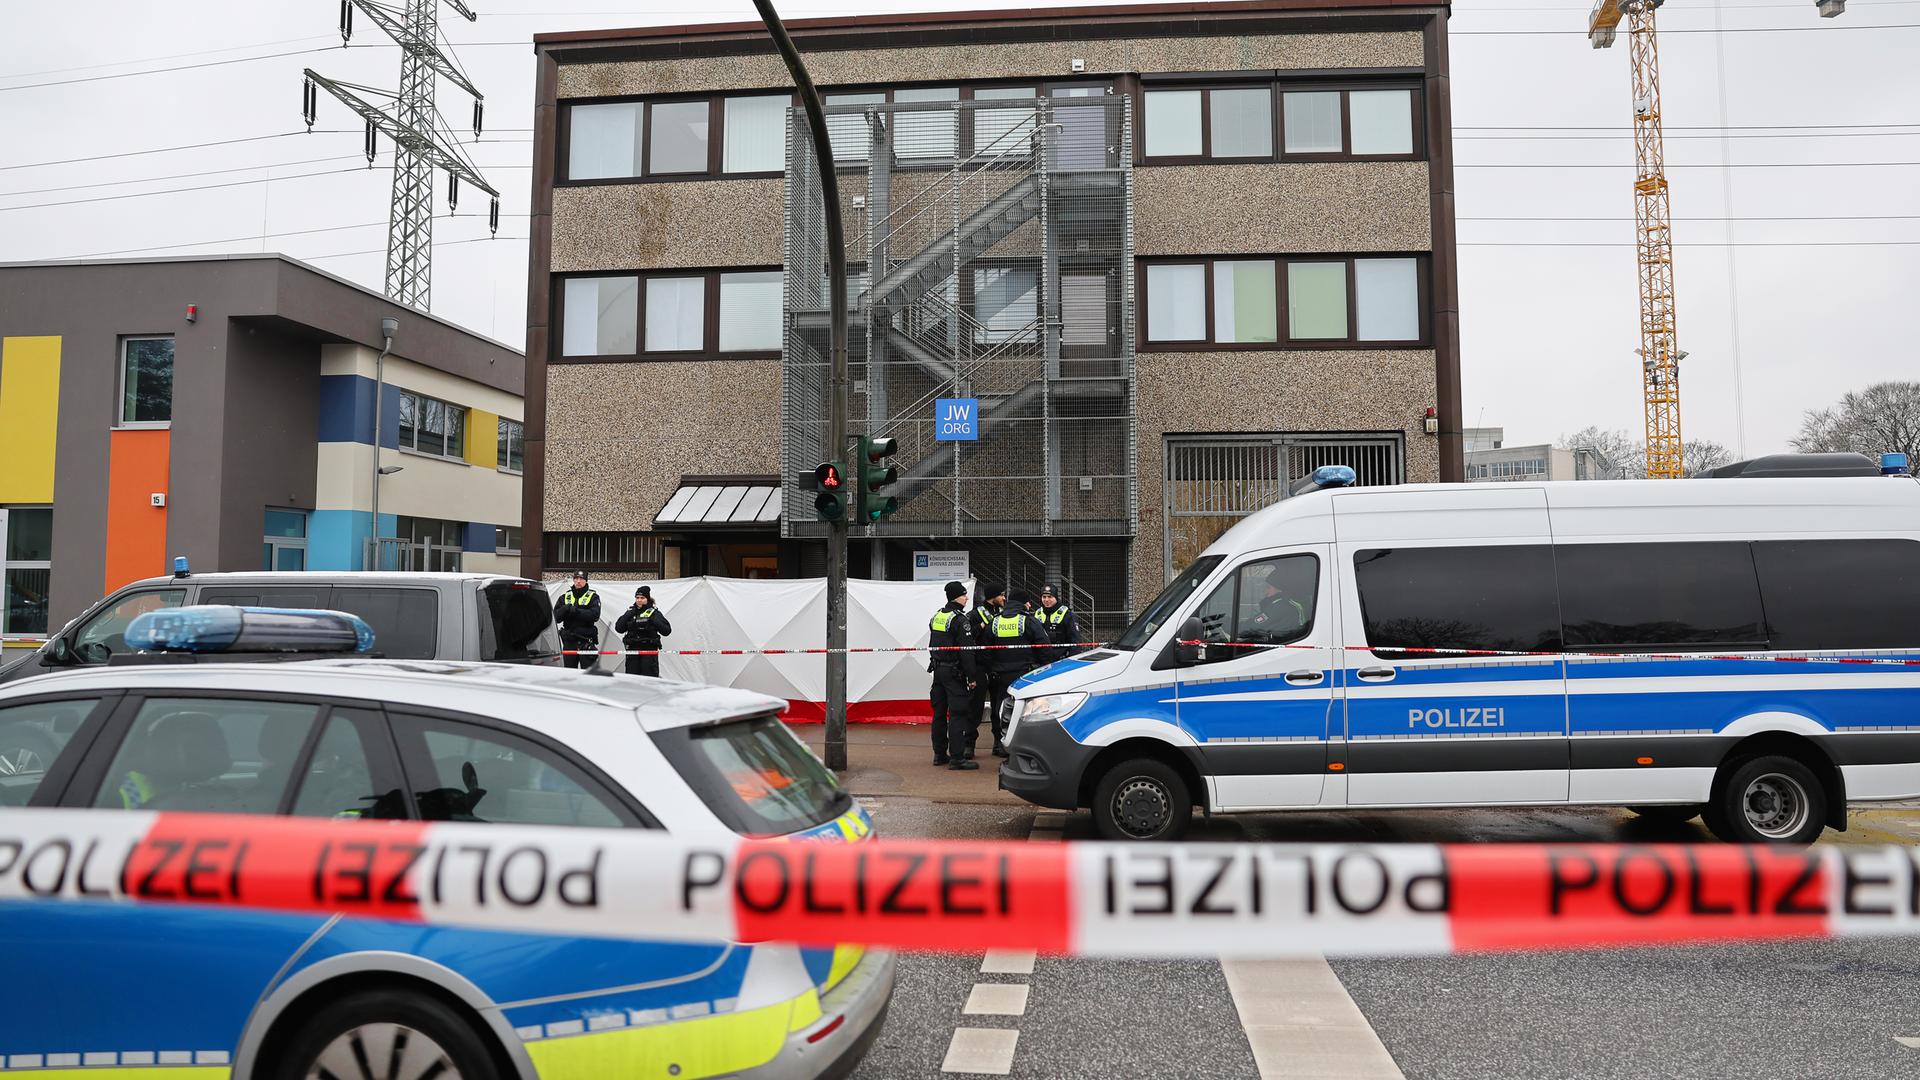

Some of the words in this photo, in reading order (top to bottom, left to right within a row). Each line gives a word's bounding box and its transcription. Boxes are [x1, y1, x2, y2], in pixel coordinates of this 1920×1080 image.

[944, 405, 970, 421] JW
[941, 422, 970, 434] .ORG
[153, 496, 160, 504] 15
[1409, 707, 1504, 728] POLIZEI
[312, 841, 603, 907] POLIZEI
[681, 850, 1012, 915] POLIZEI
[1106, 850, 1452, 914] POLIZEI
